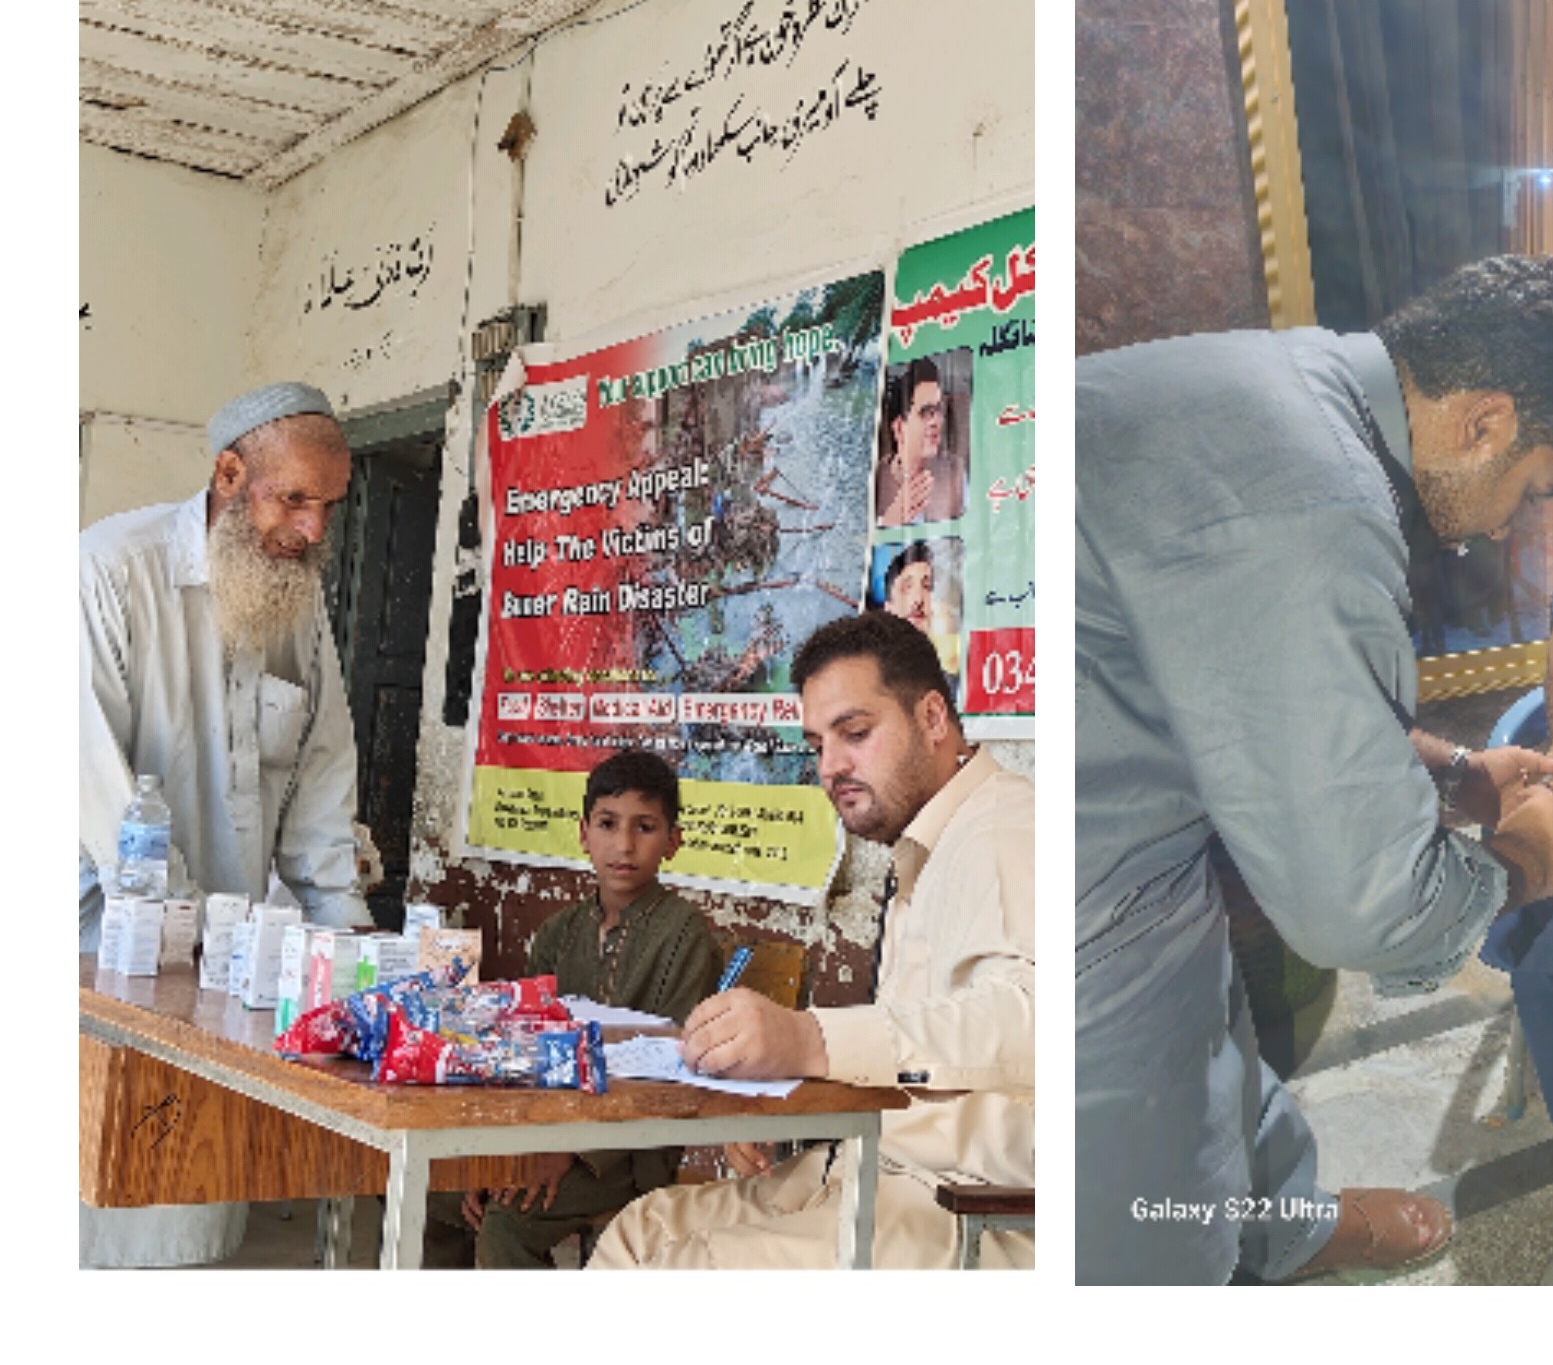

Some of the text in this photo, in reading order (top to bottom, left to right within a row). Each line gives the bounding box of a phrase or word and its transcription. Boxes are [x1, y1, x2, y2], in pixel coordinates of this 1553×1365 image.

[505, 478, 623, 517] Emergency
[503, 513, 716, 569] Help The Victims of
[562, 586, 612, 617] Rain
[617, 583, 711, 616] Disaster
